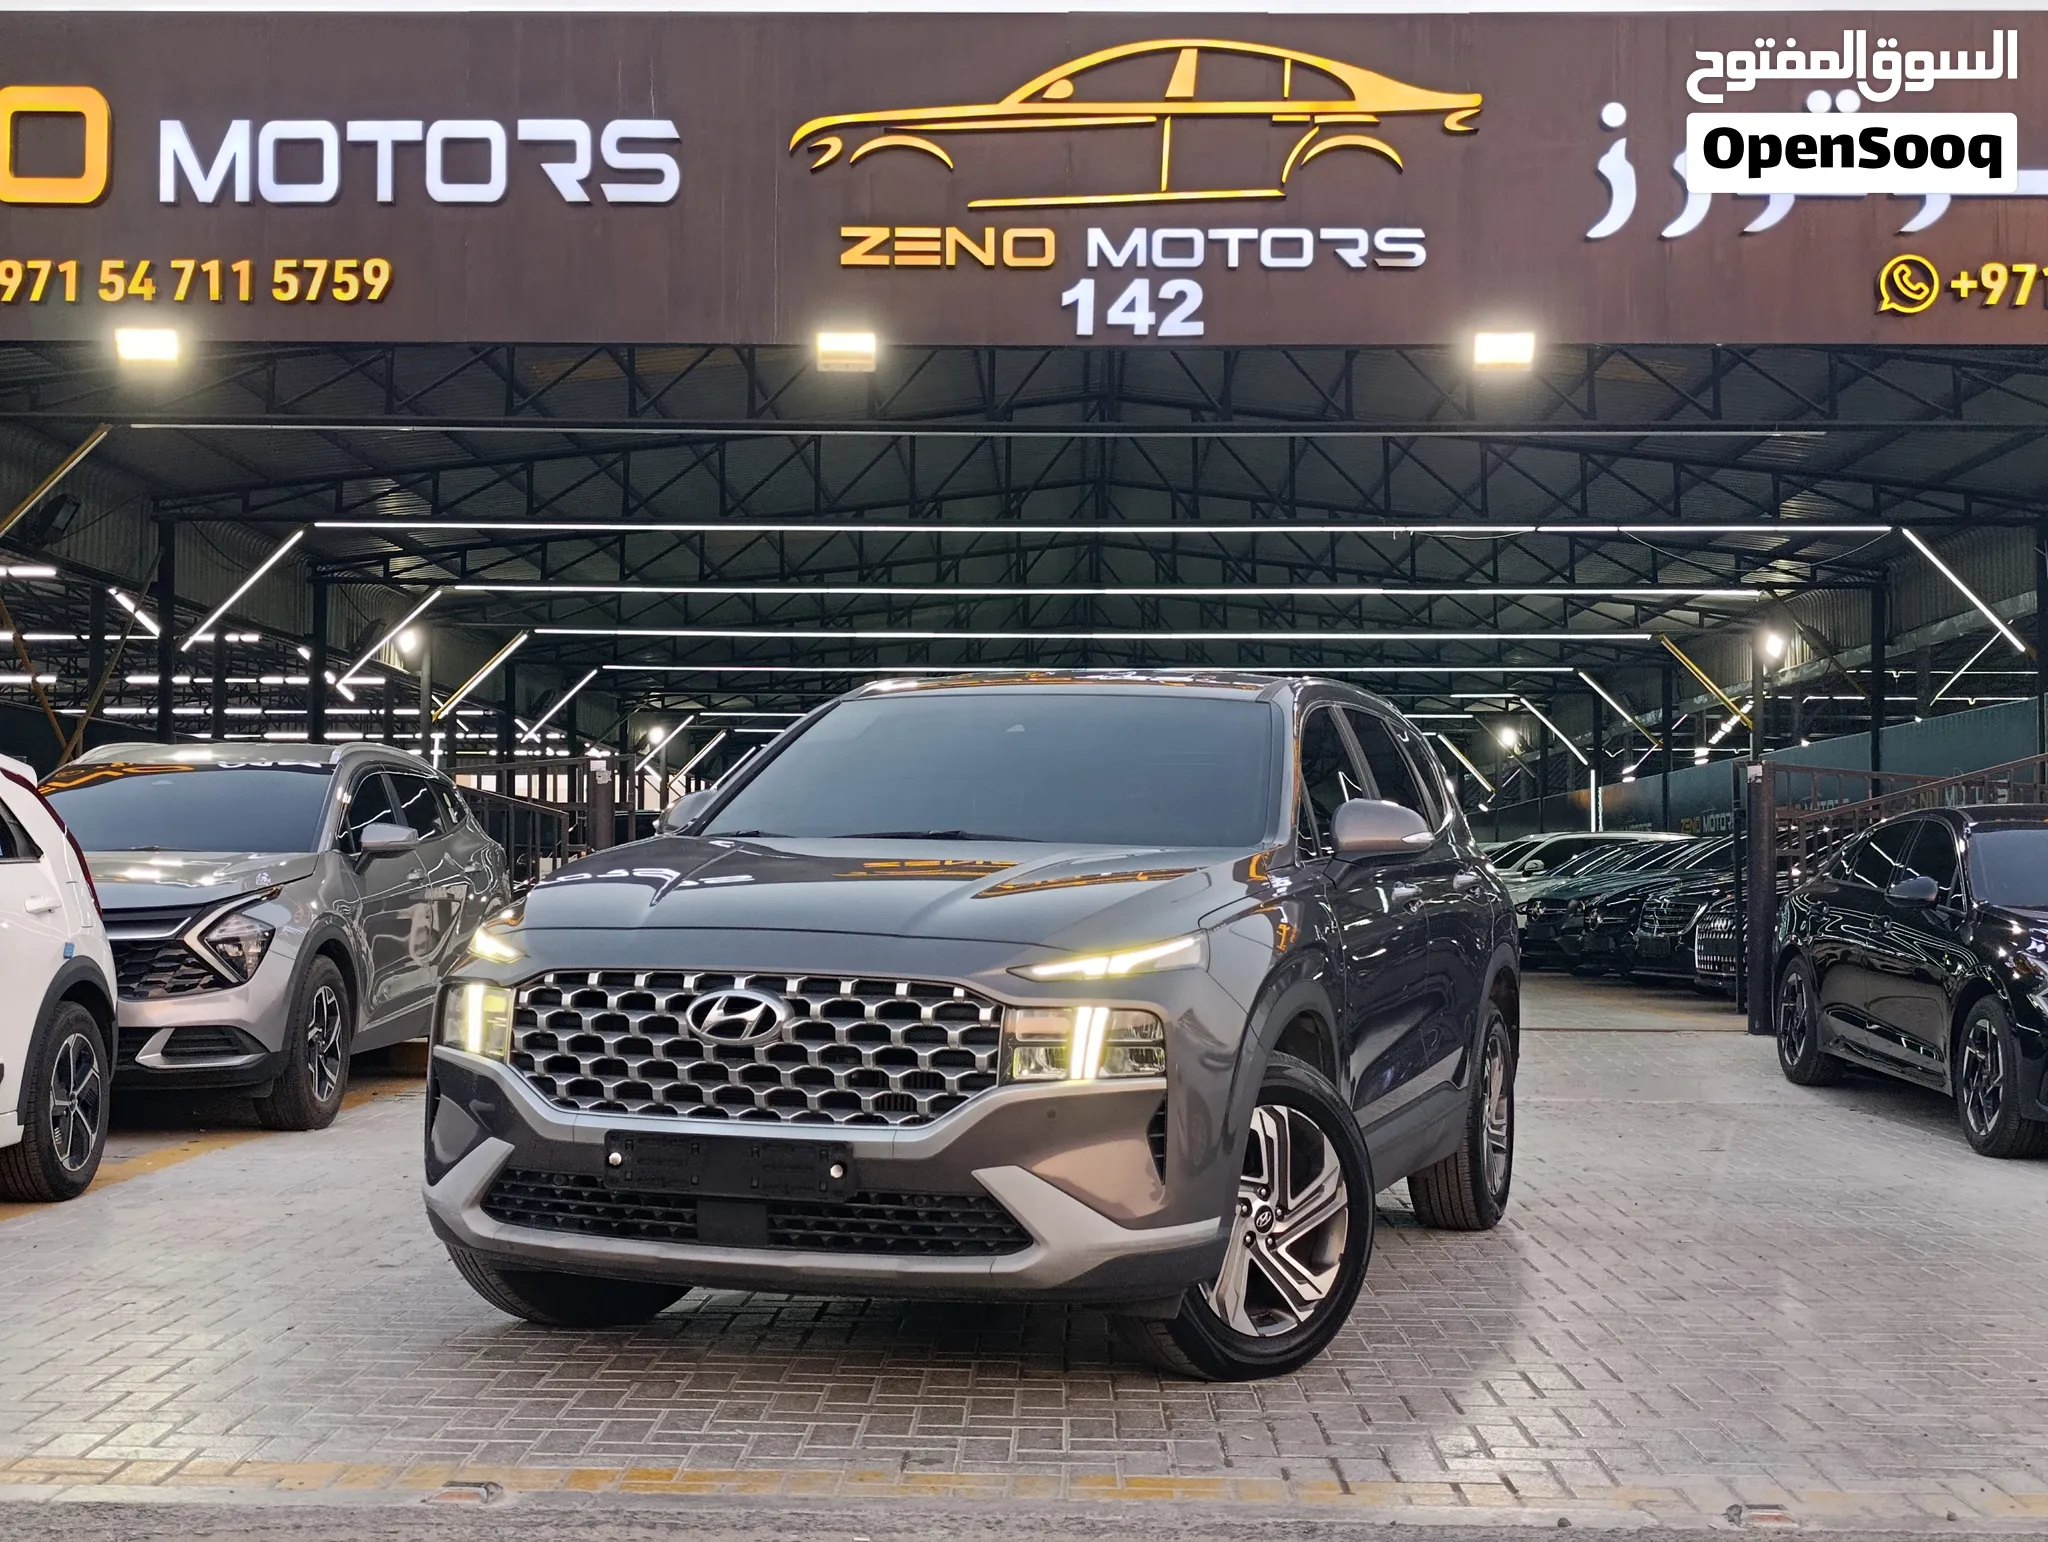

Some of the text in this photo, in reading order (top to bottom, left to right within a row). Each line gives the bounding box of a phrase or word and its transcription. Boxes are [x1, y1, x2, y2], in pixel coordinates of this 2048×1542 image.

[159, 119, 680, 203] MOTORS
[840, 226, 1427, 268] ZENO MOTORS
[0, 258, 391, 302] 971 54 711 5759
[1061, 278, 1204, 337] 142
